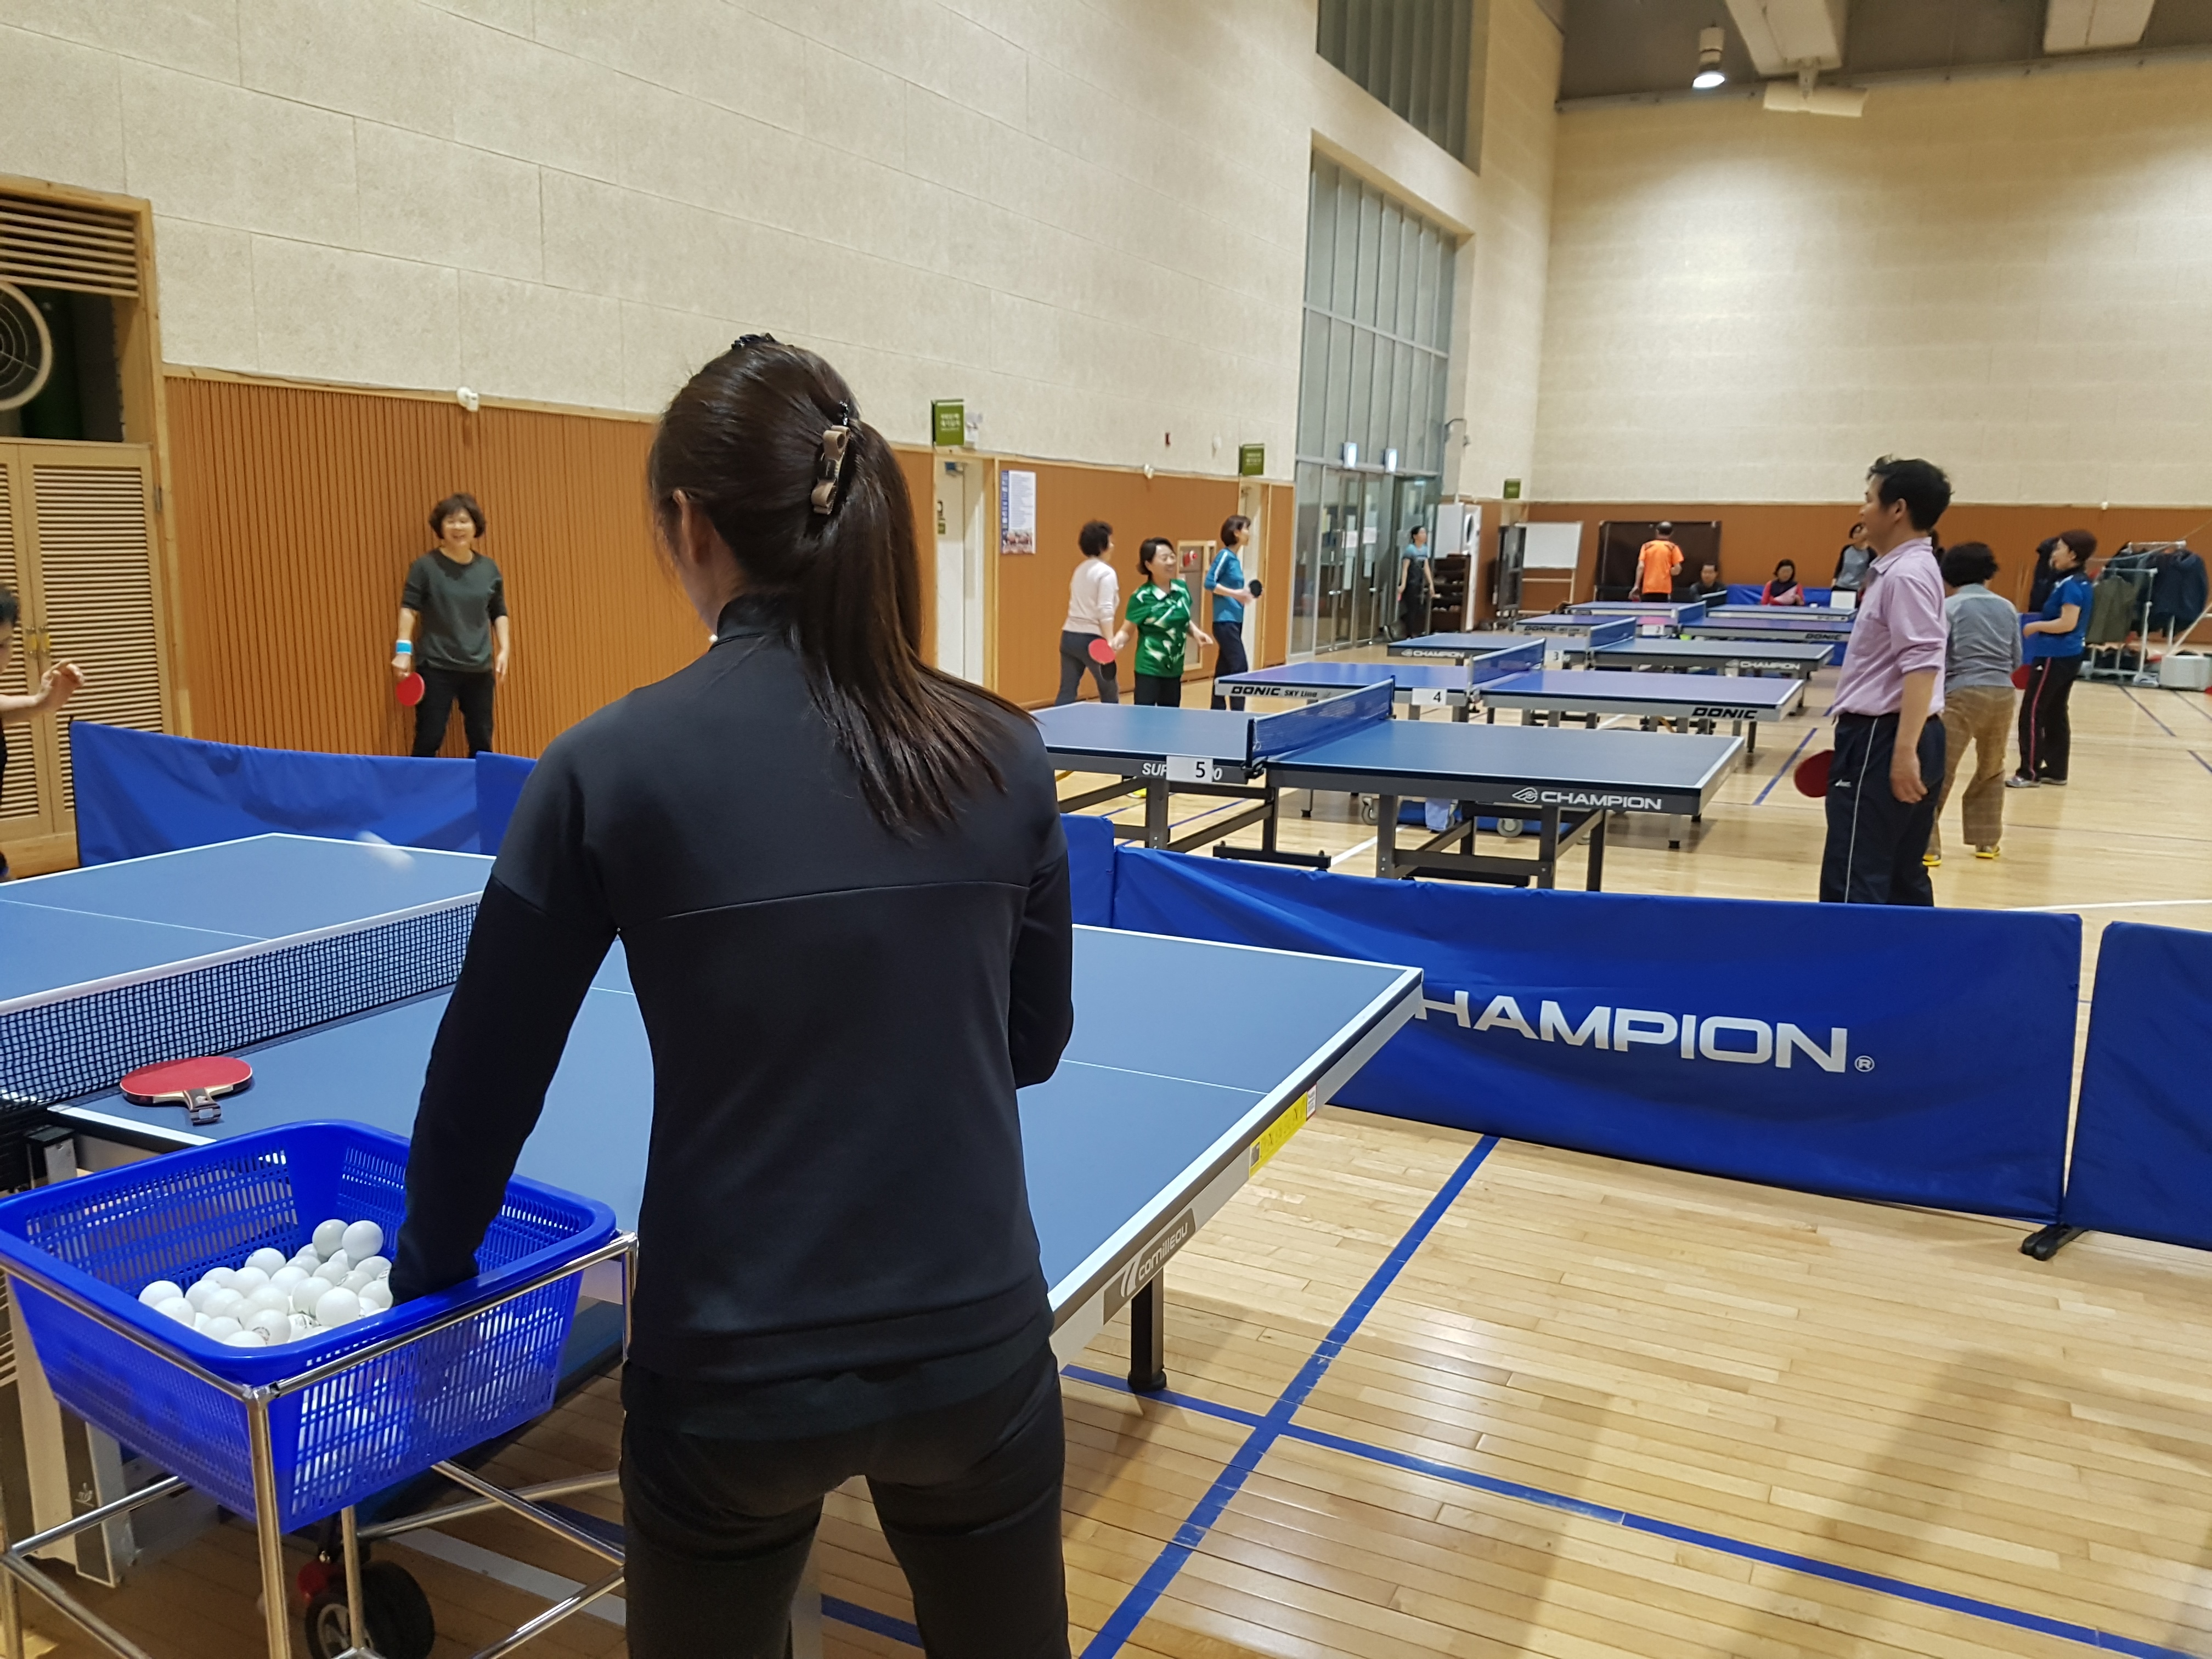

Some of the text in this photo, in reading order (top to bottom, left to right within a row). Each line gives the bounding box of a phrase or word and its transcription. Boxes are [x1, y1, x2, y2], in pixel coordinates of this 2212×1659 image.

[1413, 650, 1465, 658] CHAMPION
[1740, 661, 1800, 669] CHAMPION
[1231, 686, 1280, 696] DONIC
[1433, 691, 1441, 702] 4
[1692, 707, 1758, 719] DONIC
[1195, 761, 1205, 778] 5
[1541, 791, 1662, 810] CHAMPION
[1414, 990, 1847, 1073] HAMPION
